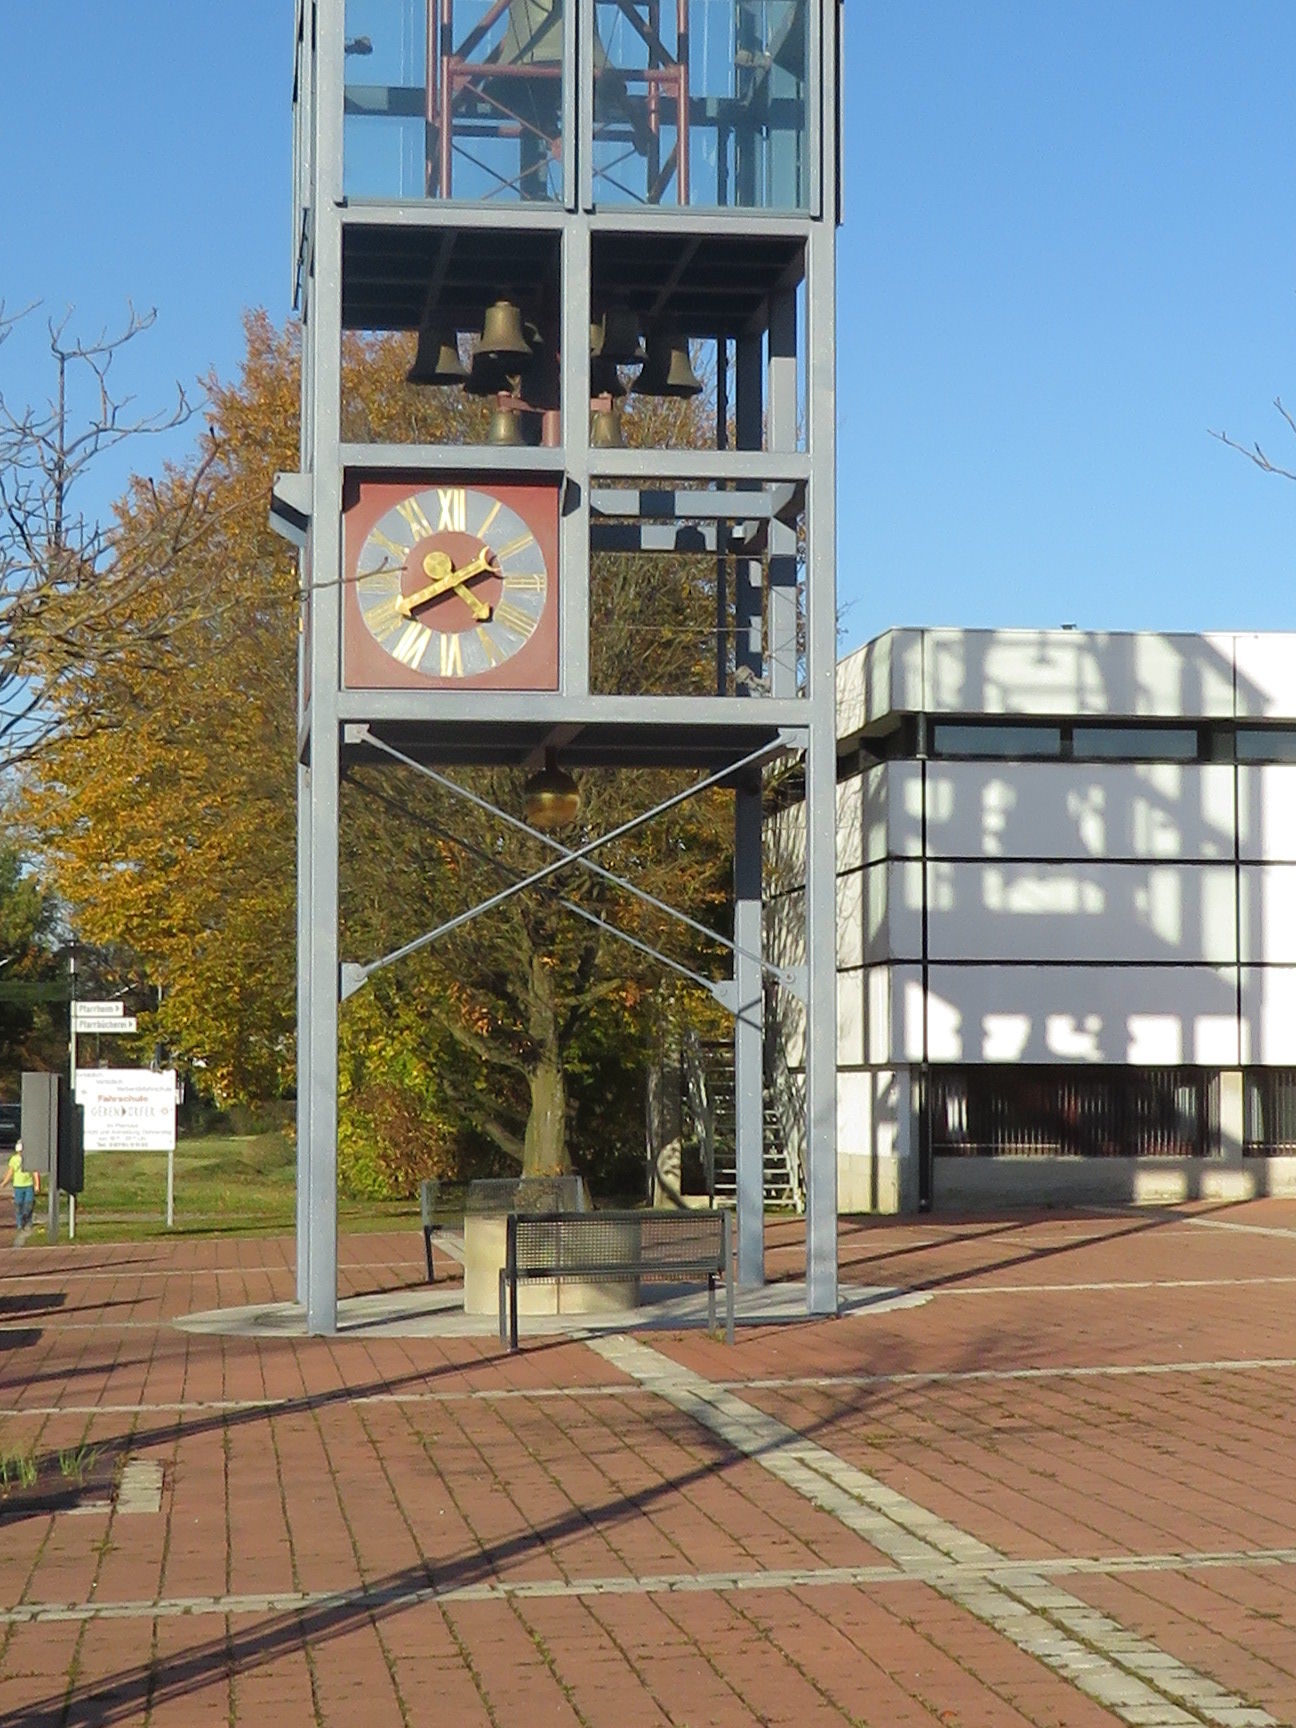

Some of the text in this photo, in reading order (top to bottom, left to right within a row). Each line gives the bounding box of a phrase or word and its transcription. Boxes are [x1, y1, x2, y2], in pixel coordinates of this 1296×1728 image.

[437, 488, 466, 532] XII
[396, 496, 433, 542] XI
[78, 1005, 114, 1013] Pfarrheim
[79, 1019, 127, 1029] Pfarrbücherei
[97, 1094, 149, 1103] Fahrschule
